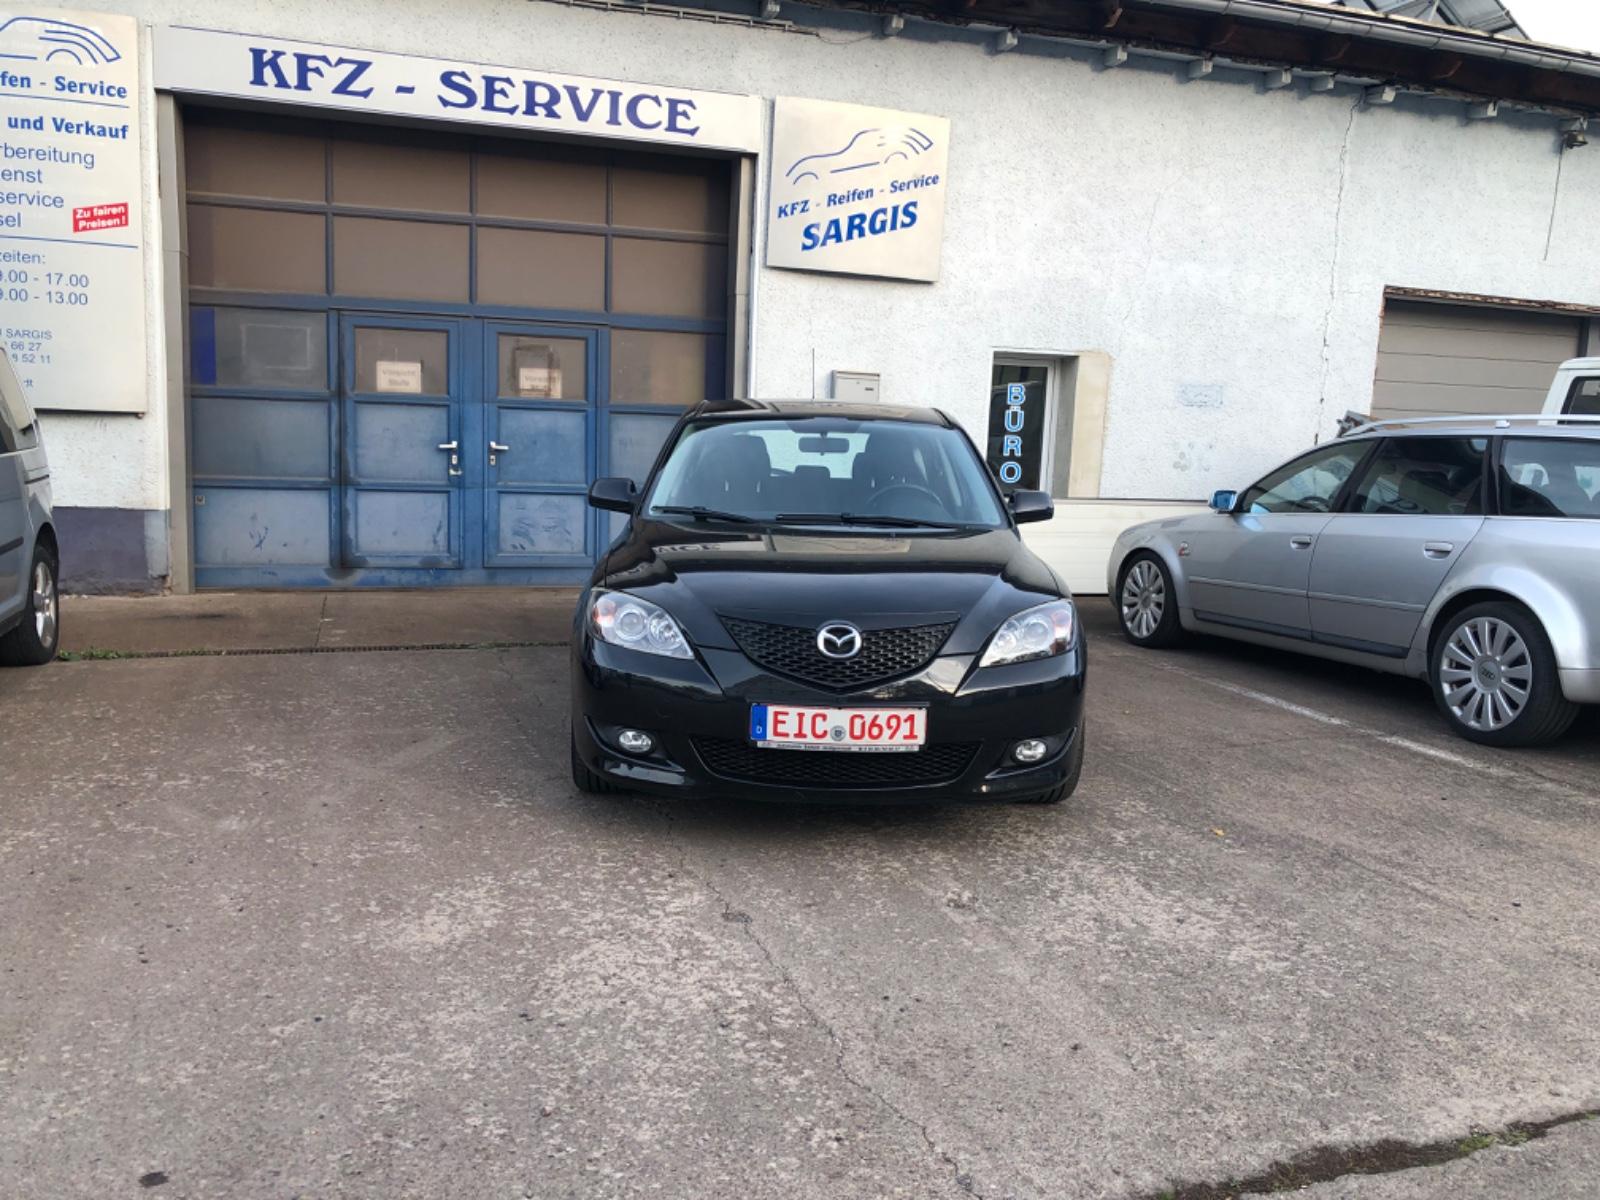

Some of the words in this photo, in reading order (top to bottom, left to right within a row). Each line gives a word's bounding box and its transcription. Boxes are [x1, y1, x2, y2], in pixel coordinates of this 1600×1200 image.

[54, 75, 128, 99] Service
[249, 47, 374, 99] KFZ
[437, 70, 700, 136] SERVICE
[7, 116, 44, 131] und
[52, 117, 129, 139] Verkauf
[777, 200, 811, 219] KFZ
[826, 187, 874, 207] Reifen
[889, 174, 940, 194] Service
[76, 208, 91, 219] Zu
[93, 205, 125, 217] fairen
[78, 218, 120, 231] Preisen
[801, 201, 918, 251] SARGIS
[0, 250, 46, 265] eiten:
[45, 272, 89, 288] 17.00
[46, 291, 88, 305] 13.00
[6, 328, 53, 341] SARGIS
[1000, 383, 1026, 483] BÜRO
[772, 710, 828, 739] EIC
[849, 713, 918, 740] 0691
